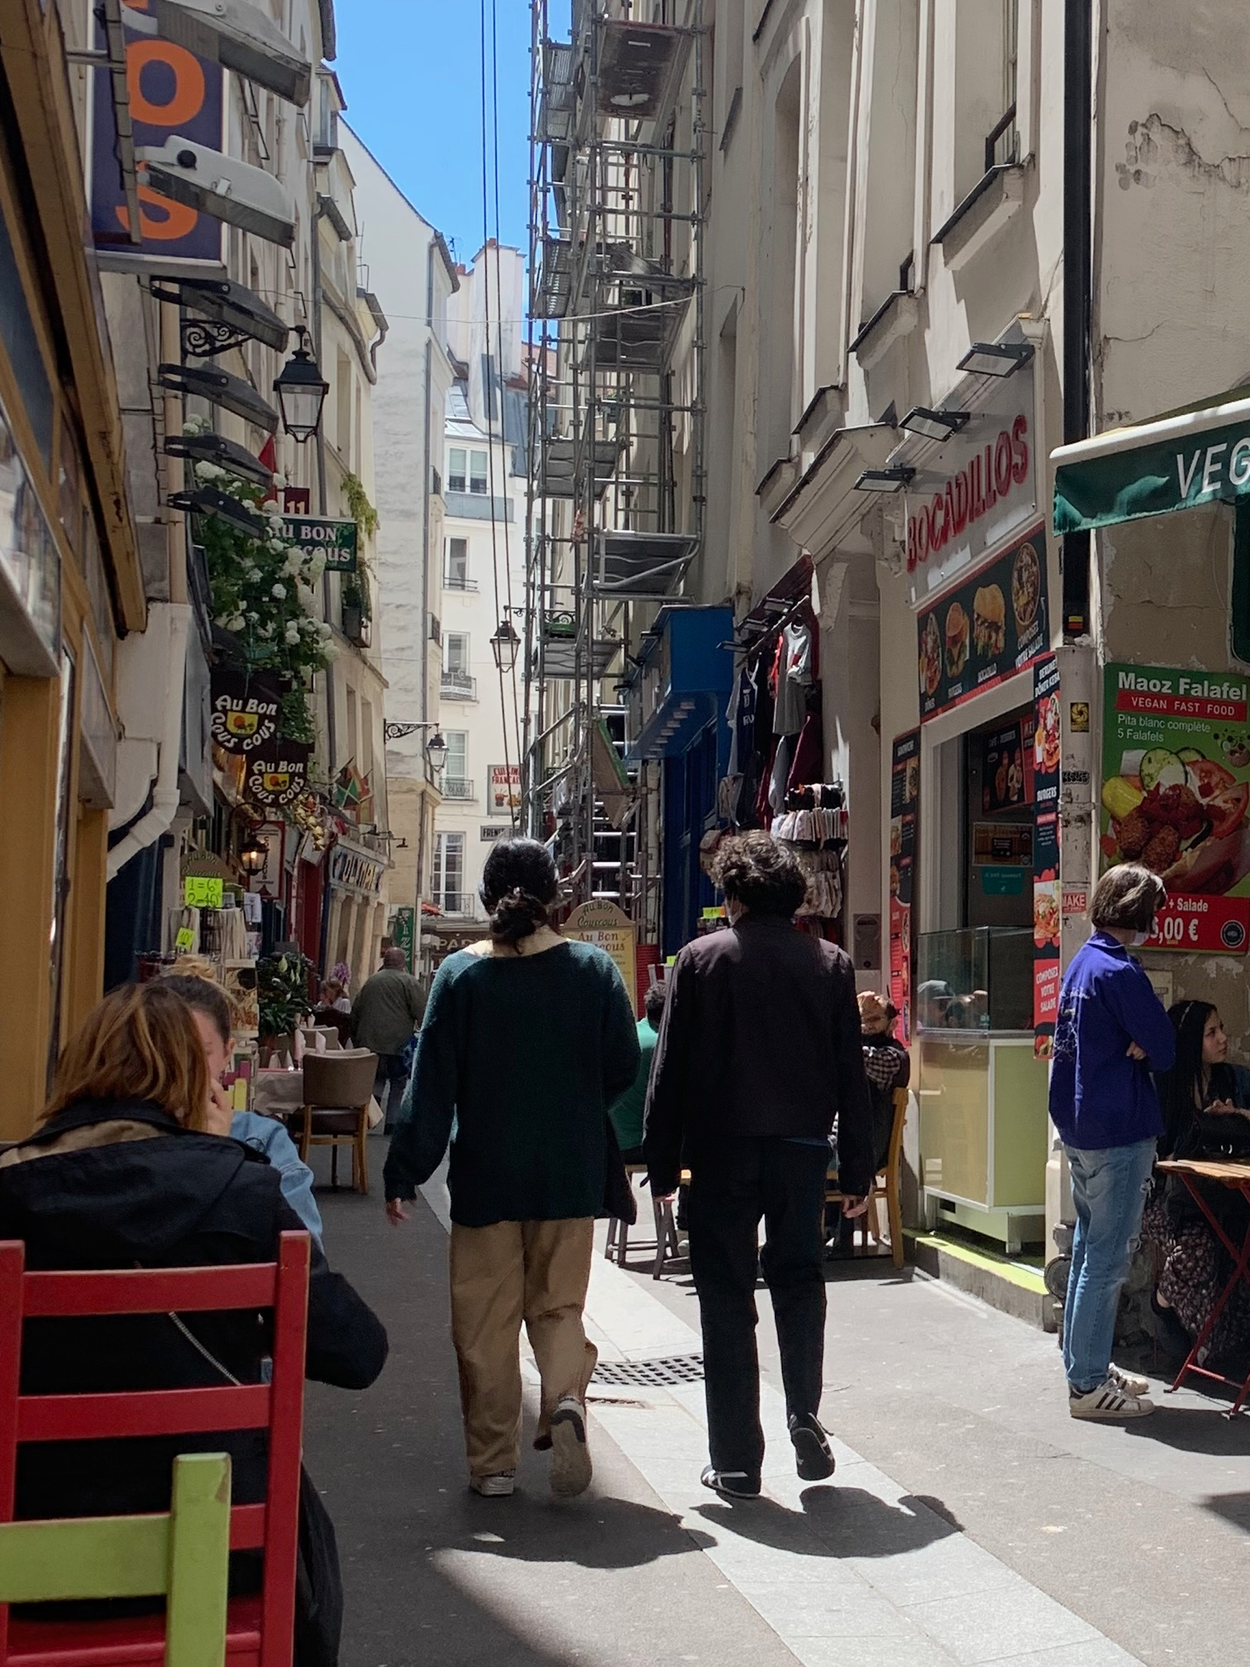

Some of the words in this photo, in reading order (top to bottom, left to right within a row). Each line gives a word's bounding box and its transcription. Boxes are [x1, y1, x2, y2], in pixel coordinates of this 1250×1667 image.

[907, 413, 1029, 574] BOCADILLOS
[300, 525, 337, 541] BON
[1117, 671, 1173, 695] Maoz
[1178, 677, 1248, 700] Falafel
[214, 694, 244, 711] Au
[245, 698, 278, 716] Bon
[1131, 696, 1168, 709] VEGAN
[1173, 700, 1201, 713] FAST
[1206, 704, 1235, 717] FOOD
[1117, 714, 1138, 727] Pita
[1139, 715, 1167, 729] blanc
[1166, 717, 1212, 735] complète
[1117, 728, 1125, 739] 5
[1126, 728, 1165, 743] Falafels
[252, 759, 275, 774] Au
[278, 760, 304, 773] Bon
[1036, 785, 1057, 802] BURGERS
[582, 903, 595, 916] Au
[597, 901, 614, 914] Bon
[1176, 897, 1209, 913] Salade
[577, 916, 618, 928] Couscous
[1188, 918, 1199, 942] €
[577, 932, 593, 942] Au
[597, 931, 619, 941] Bon
[1035, 966, 1059, 985] COMPOSEZ
[1040, 982, 1055, 998] VOTRE
[1040, 997, 1057, 1014] SALADE
